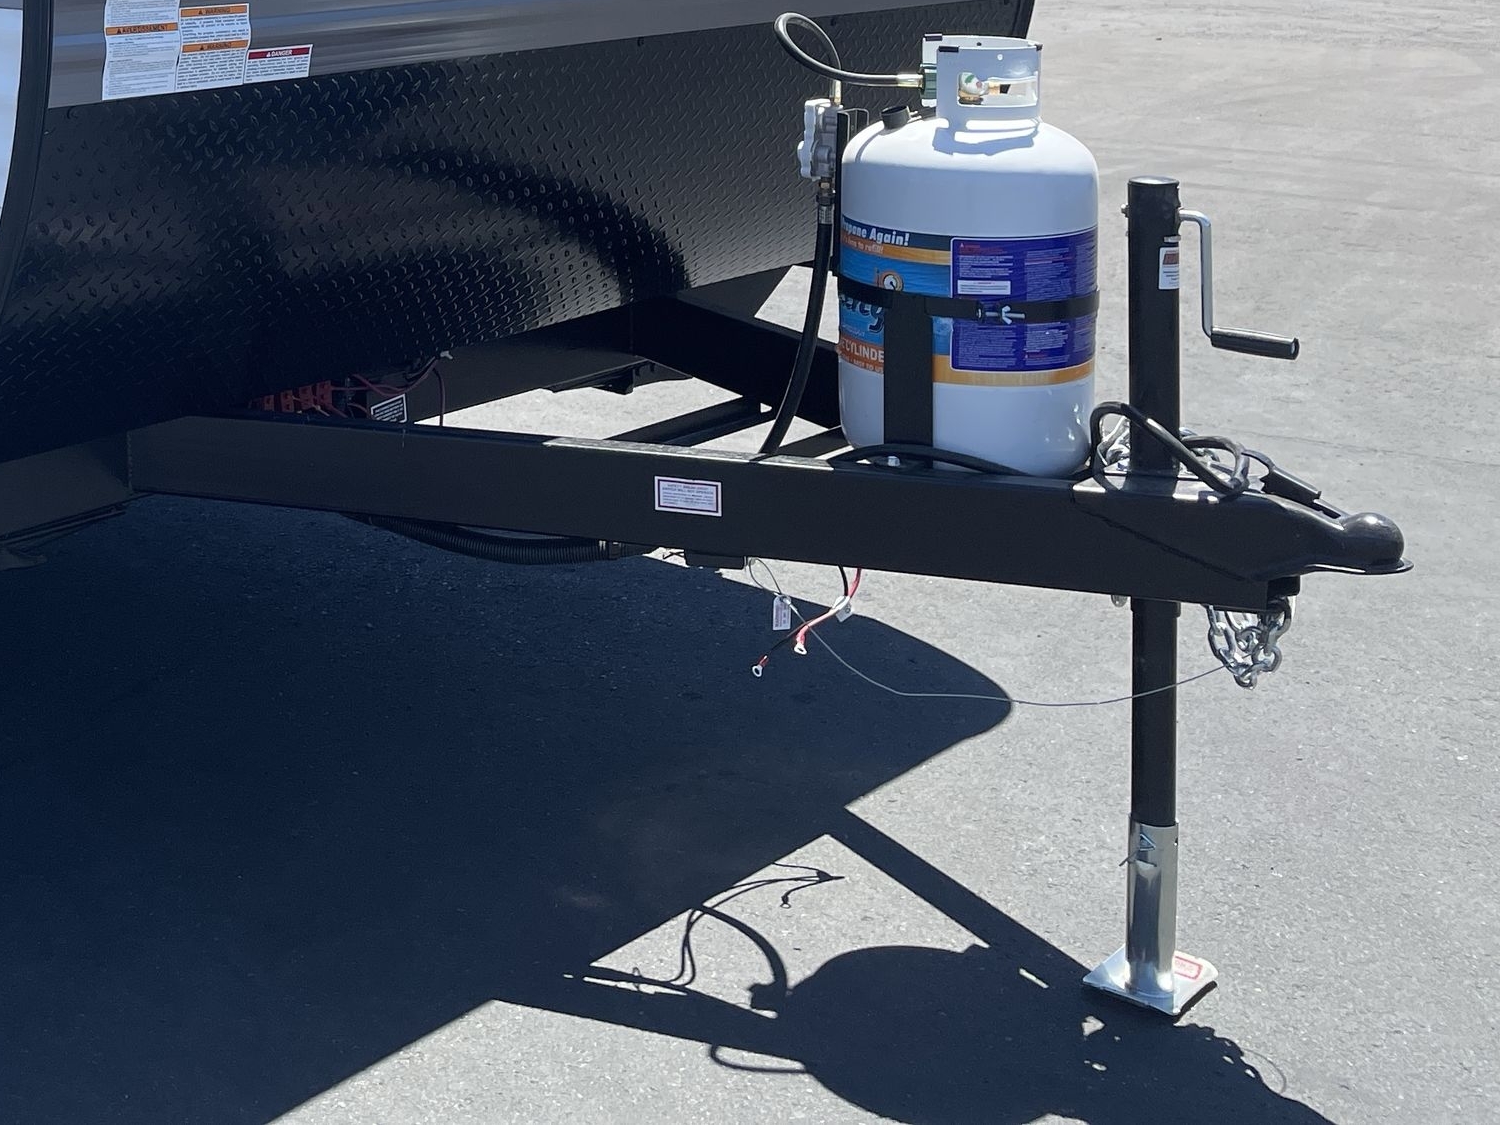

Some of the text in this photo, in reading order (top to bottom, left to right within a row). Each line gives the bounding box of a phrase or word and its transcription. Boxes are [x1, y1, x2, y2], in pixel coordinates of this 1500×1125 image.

[271, 49, 293, 57] DANGER
[869, 228, 910, 247] Again!
[845, 340, 885, 363] CYLINDE
